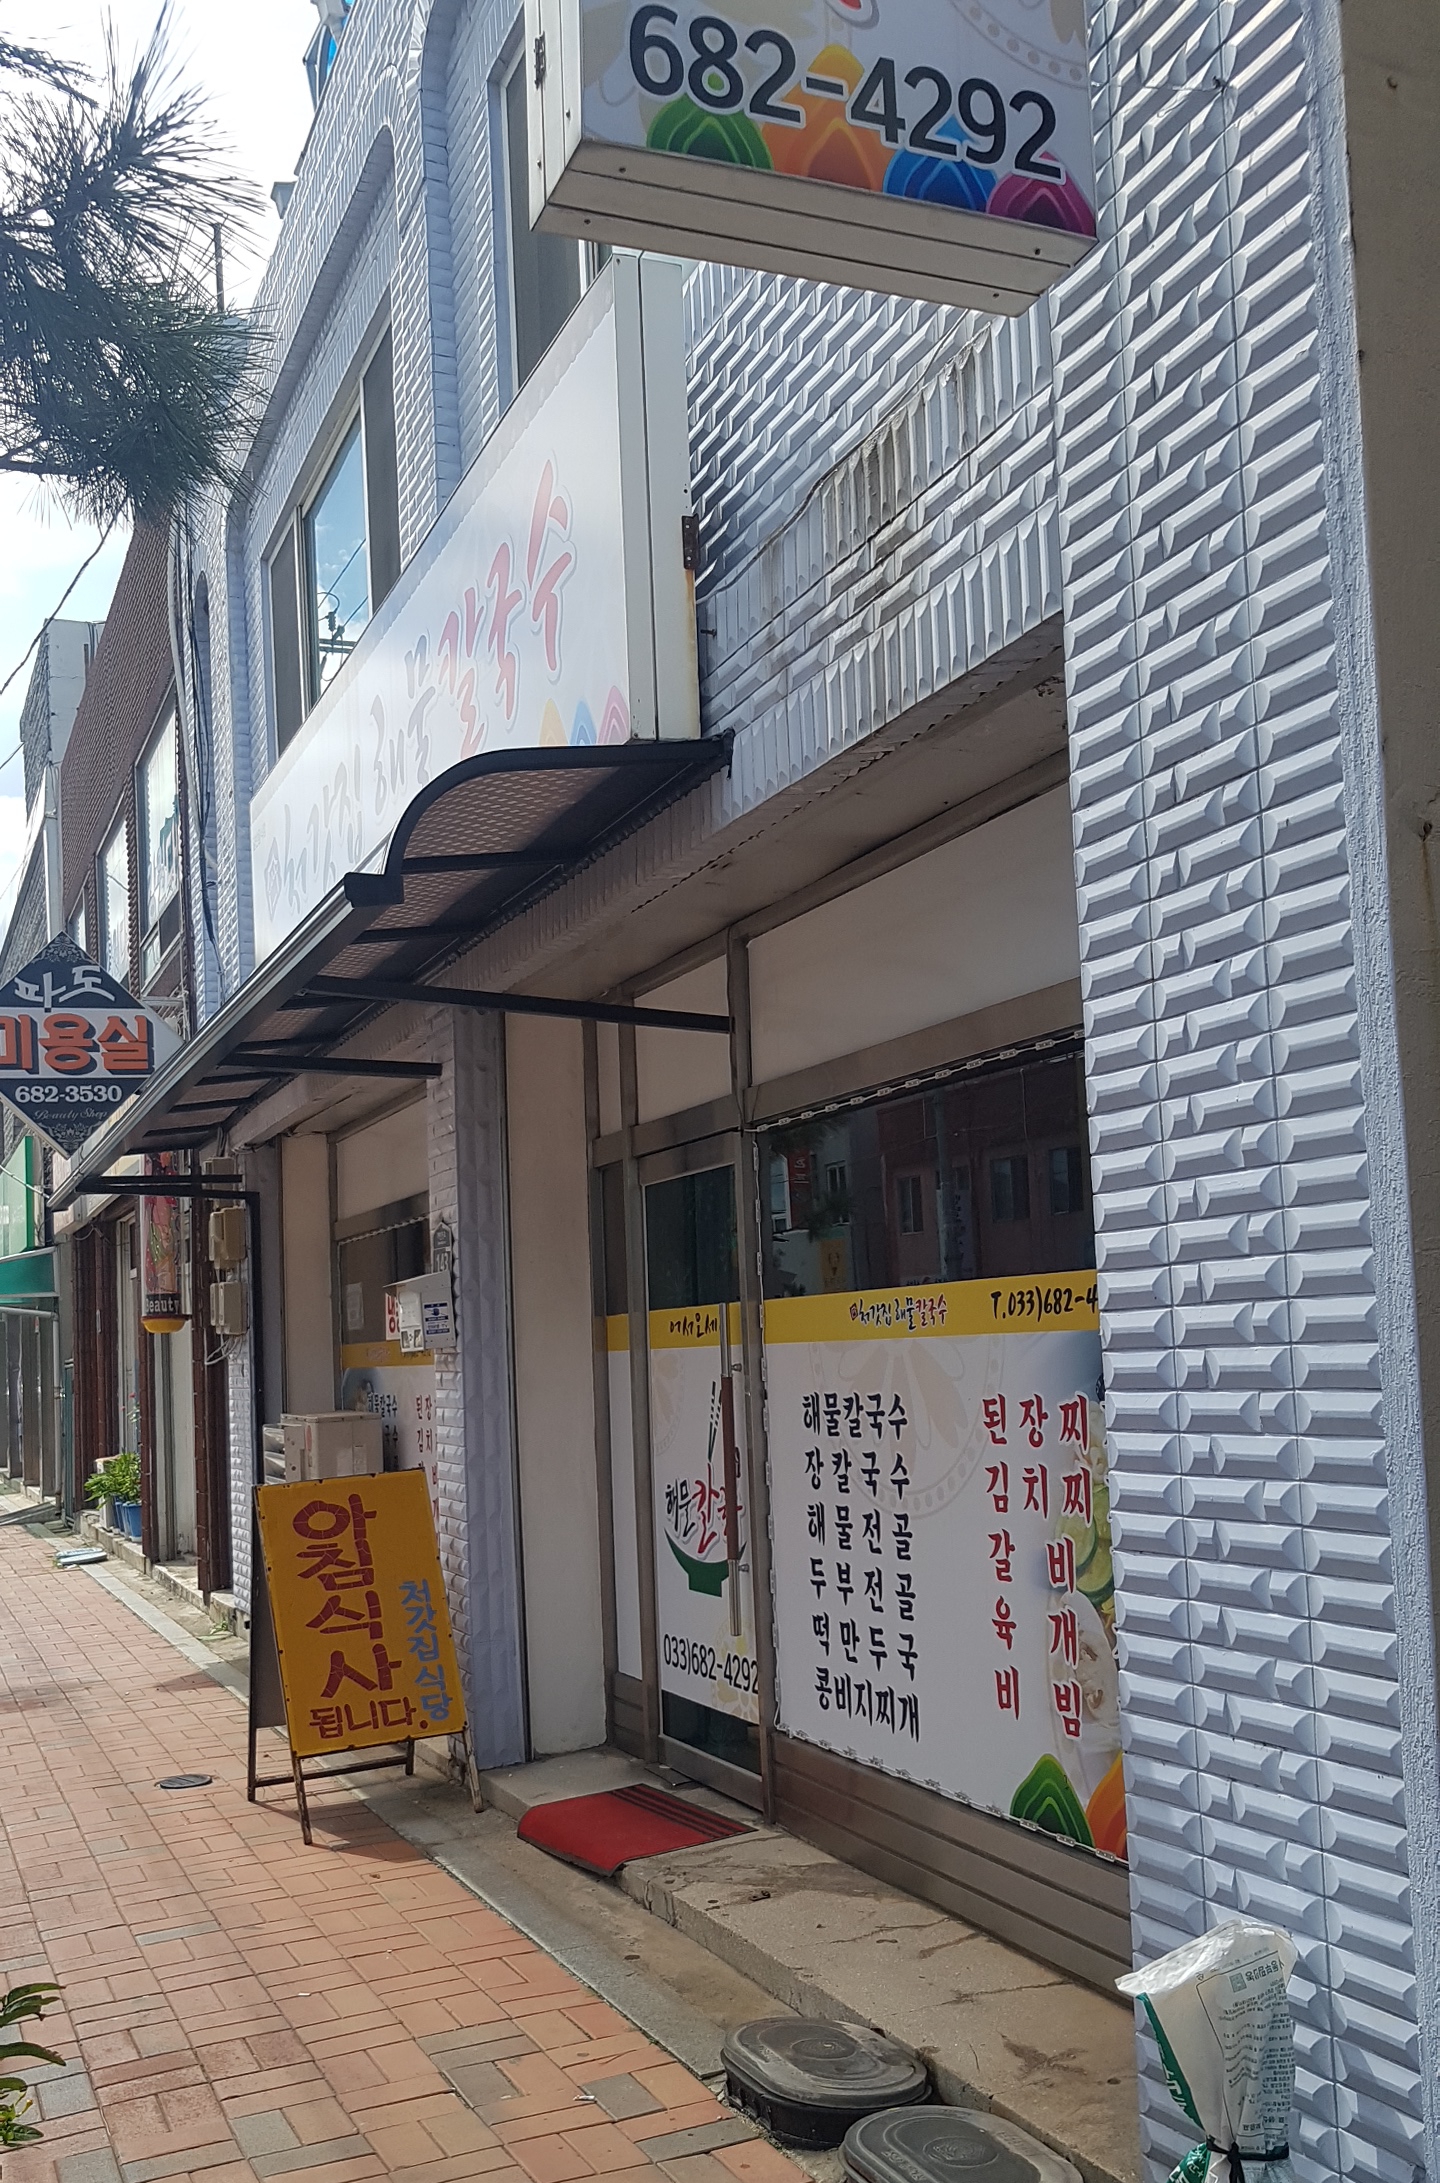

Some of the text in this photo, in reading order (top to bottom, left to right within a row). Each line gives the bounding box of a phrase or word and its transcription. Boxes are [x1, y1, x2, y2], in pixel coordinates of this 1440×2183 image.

[630, 4, 1062, 180] 682-4292
[14, 965, 116, 1010] 파도
[0, 1013, 152, 1074] 미용실
[15, 1085, 122, 1103] 682-3530
[34, 1109, 79, 1121] Beauty
[670, 1312, 720, 1338] 어서오세
[416, 1394, 436, 1420] 된장
[802, 1392, 908, 1440] 해물칼국수
[417, 1427, 436, 1454] 김치
[293, 1493, 402, 1698] 아침식사
[663, 1633, 759, 1695] 033)682-4292
[309, 1696, 429, 1740] 됩니다.
[814, 1666, 920, 1743] 콩비지찌개
